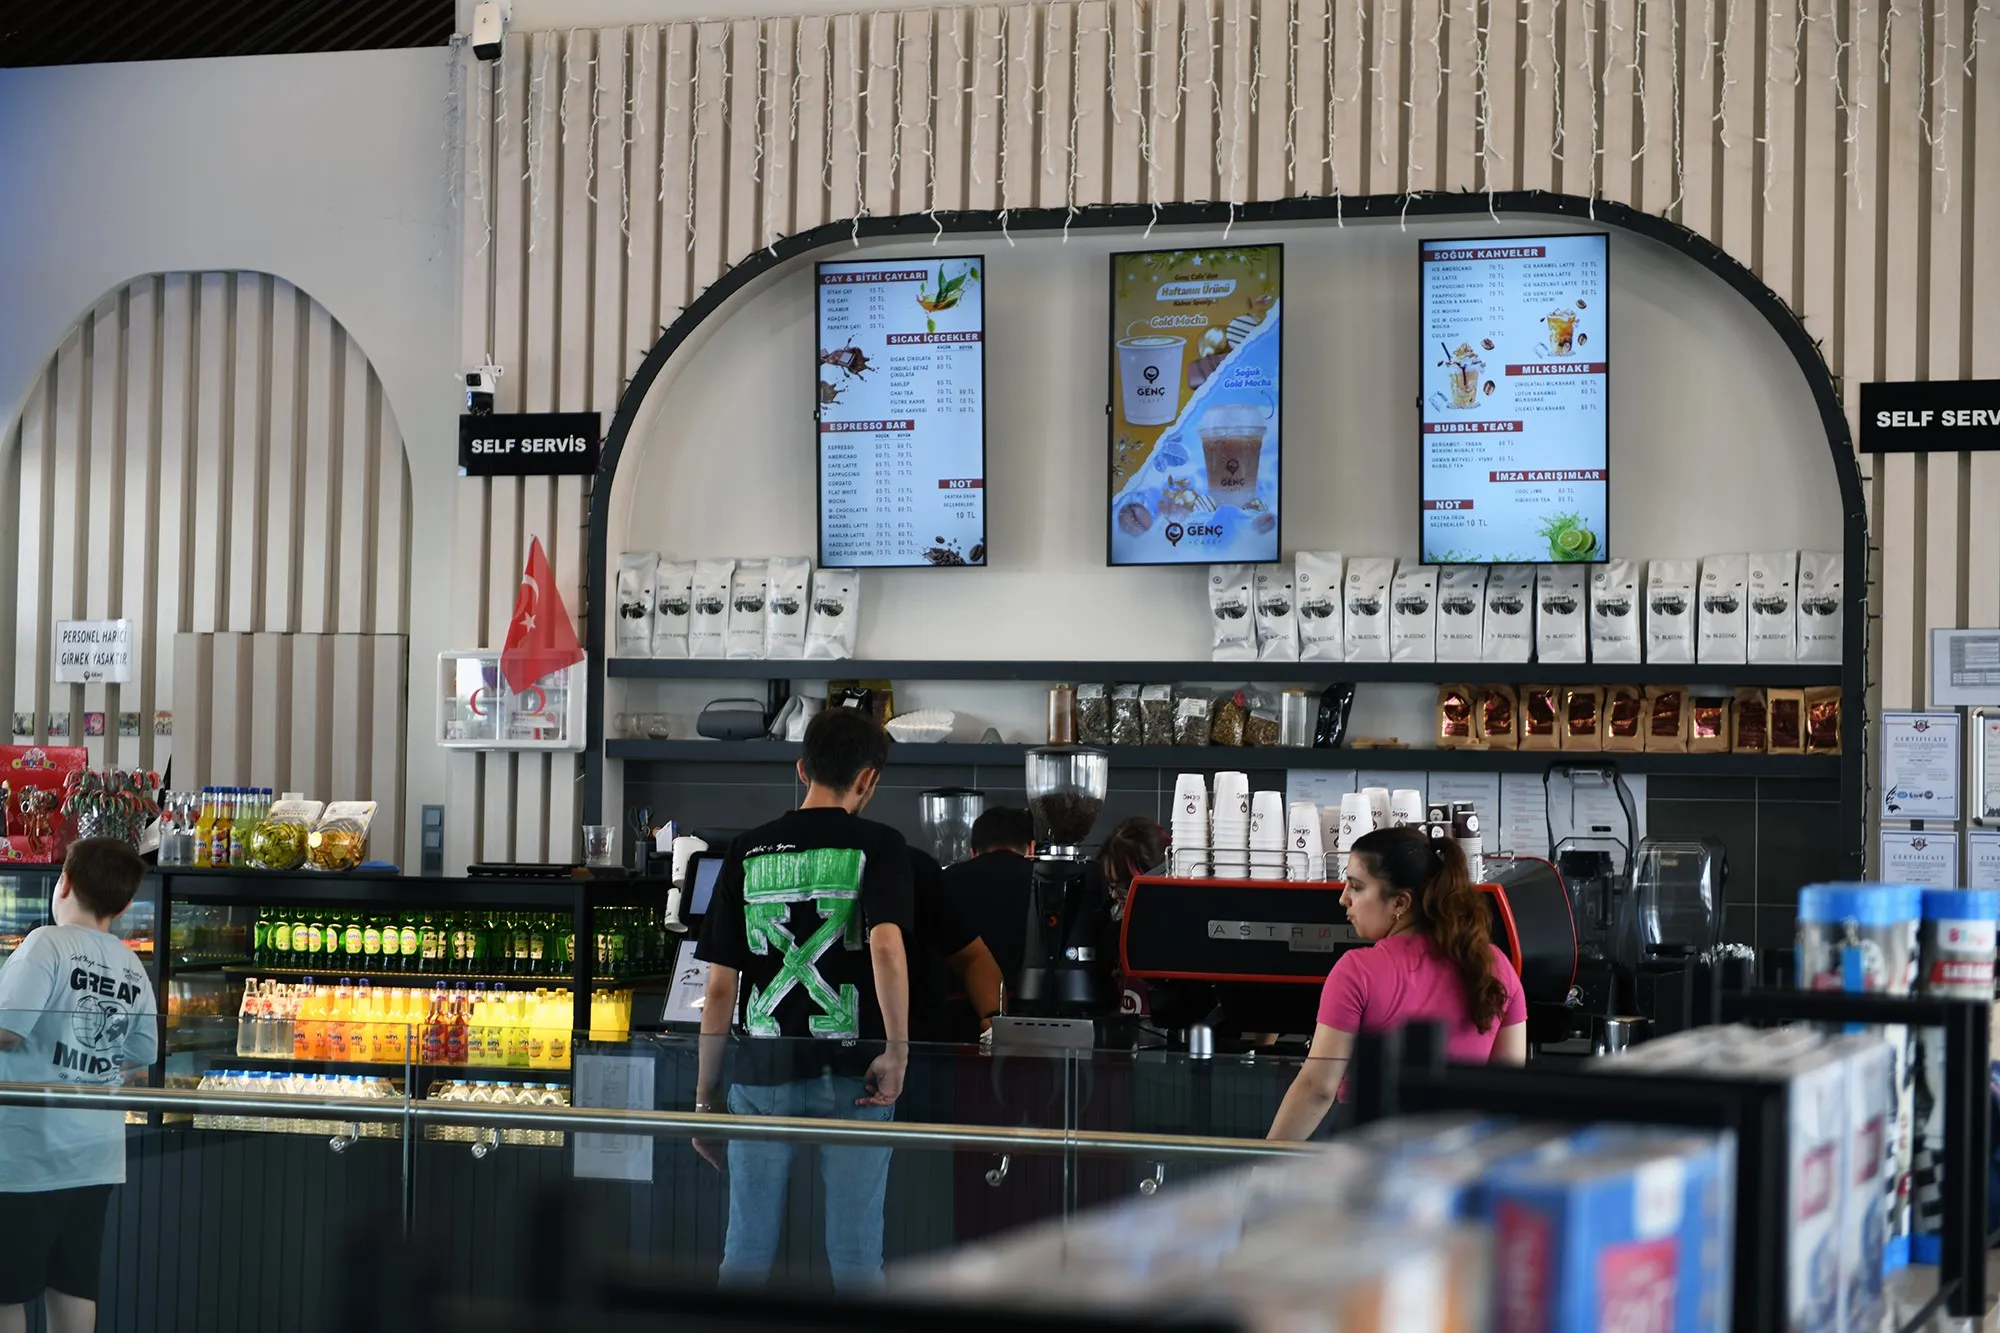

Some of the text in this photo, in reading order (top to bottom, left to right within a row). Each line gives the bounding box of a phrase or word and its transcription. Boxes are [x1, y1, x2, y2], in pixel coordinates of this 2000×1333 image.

[1434, 248, 1538, 260] SOĞUK KAHVELER
[824, 276, 844, 284] ÇAY
[856, 272, 882, 282] BİTKİ
[884, 272, 926, 282] ÇAYLARI
[1161, 282, 1230, 296] Haftanın Ürünü
[1151, 315, 1207, 327] Gold Mocha
[890, 332, 978, 344] SICAK İÇECEKLER
[1235, 368, 1260, 377] Soğuk
[1522, 364, 1590, 374] MILKSHAKE
[1244, 379, 1272, 387] Mocha
[1136, 387, 1165, 397] GENÇ
[1876, 410, 1934, 428] SELF
[829, 421, 907, 431] ESPRESSO BAR
[1434, 422, 1514, 432] BUBBLE TEA'S
[471, 434, 586, 453] SELF SERVİS
[1496, 471, 1600, 481] İMZA KARIŞIMLAR
[949, 480, 972, 488] NOT
[1220, 478, 1245, 487] GENÇ
[1436, 501, 1461, 509] NOT
[1187, 525, 1223, 537] GENÇ
[62, 630, 100, 643] PERSONEL
[61, 649, 128, 666] GİRMEK YASAKTIR
